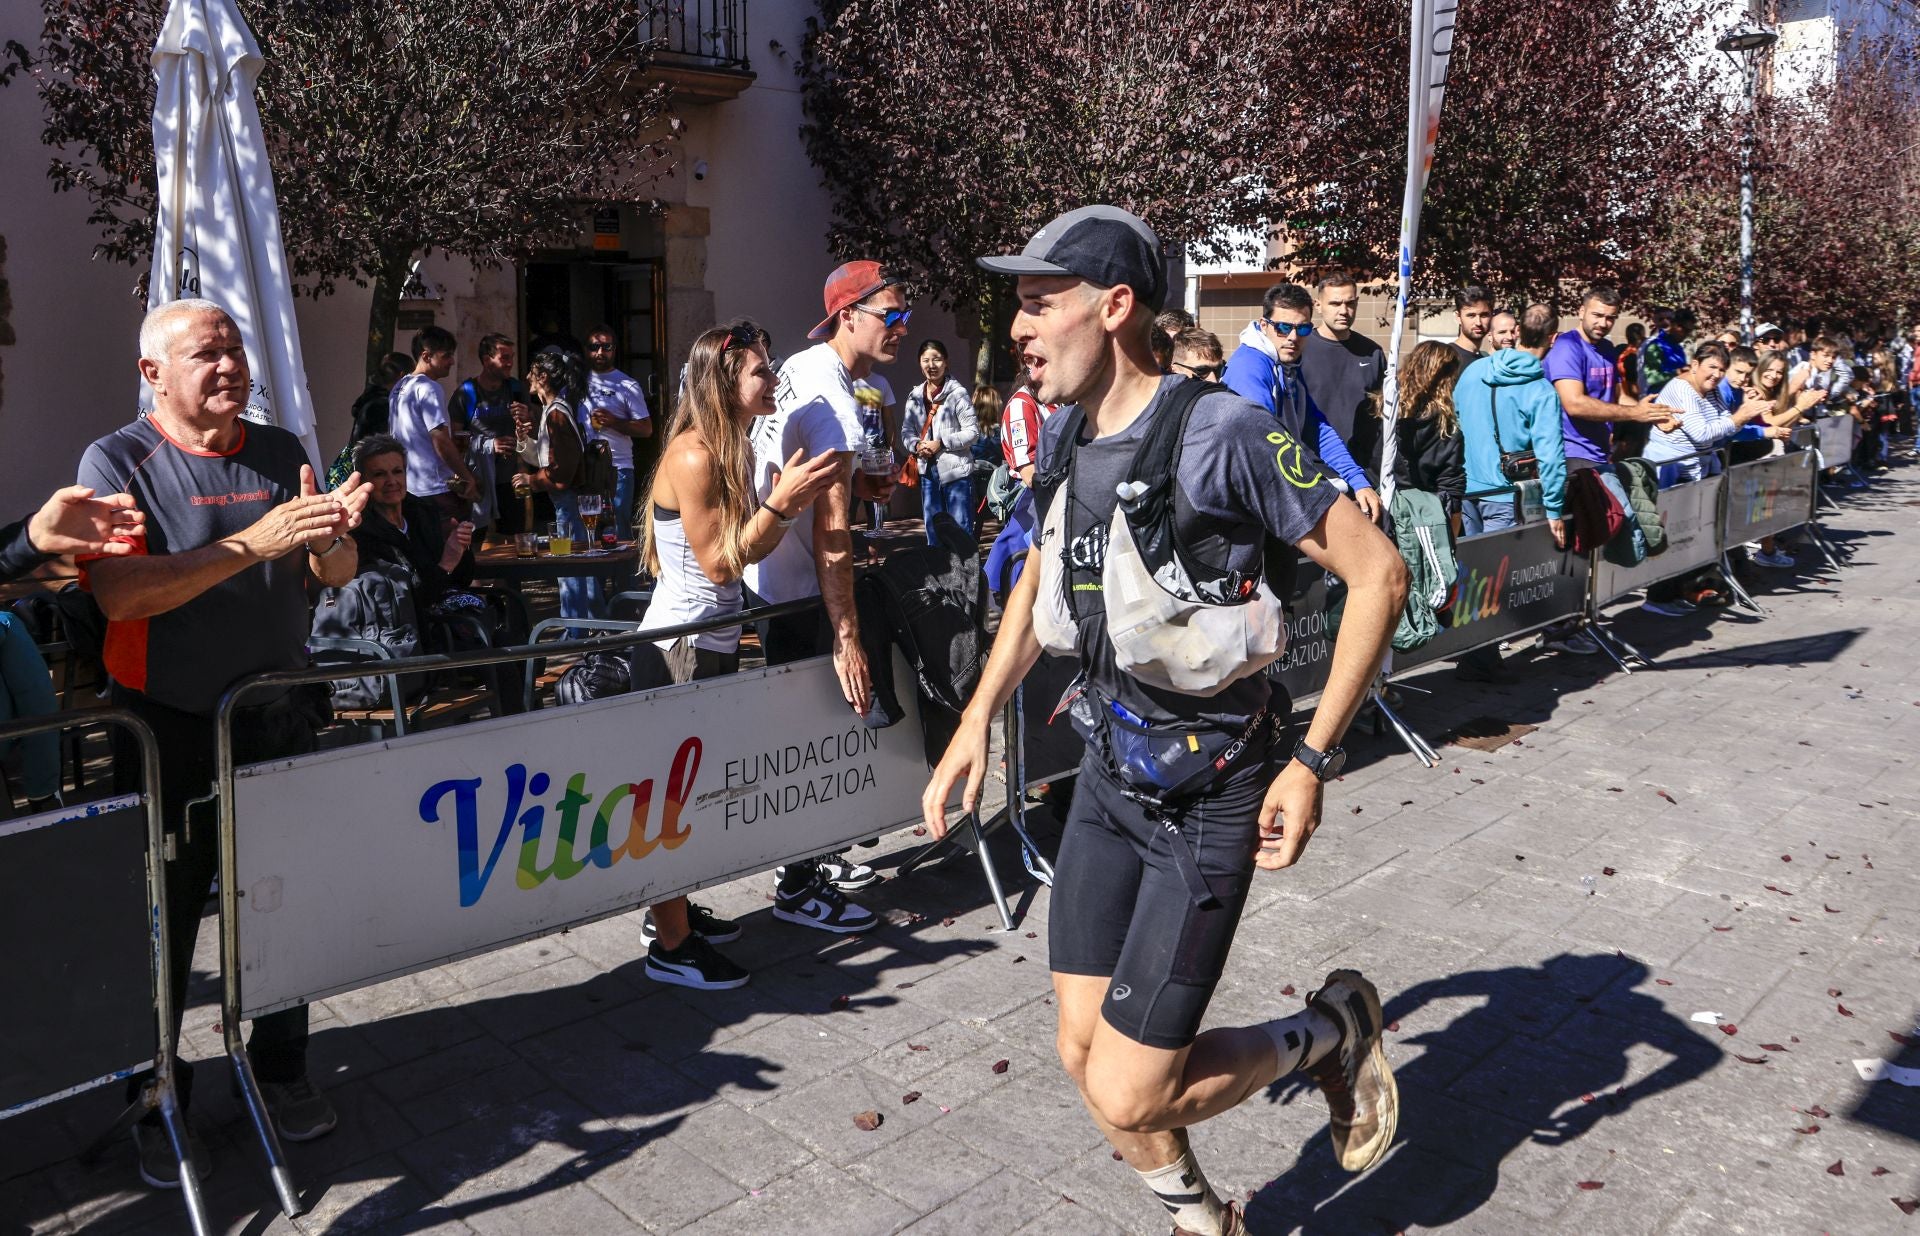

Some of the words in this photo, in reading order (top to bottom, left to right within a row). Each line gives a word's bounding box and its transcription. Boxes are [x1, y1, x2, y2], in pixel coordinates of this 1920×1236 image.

[1282, 609, 1329, 642] DACIÓN
[1445, 554, 1510, 630] ital
[418, 736, 703, 907] Vital
[724, 724, 880, 788] FUNDACIÓN
[724, 762, 877, 831] FUNDAZIOA
